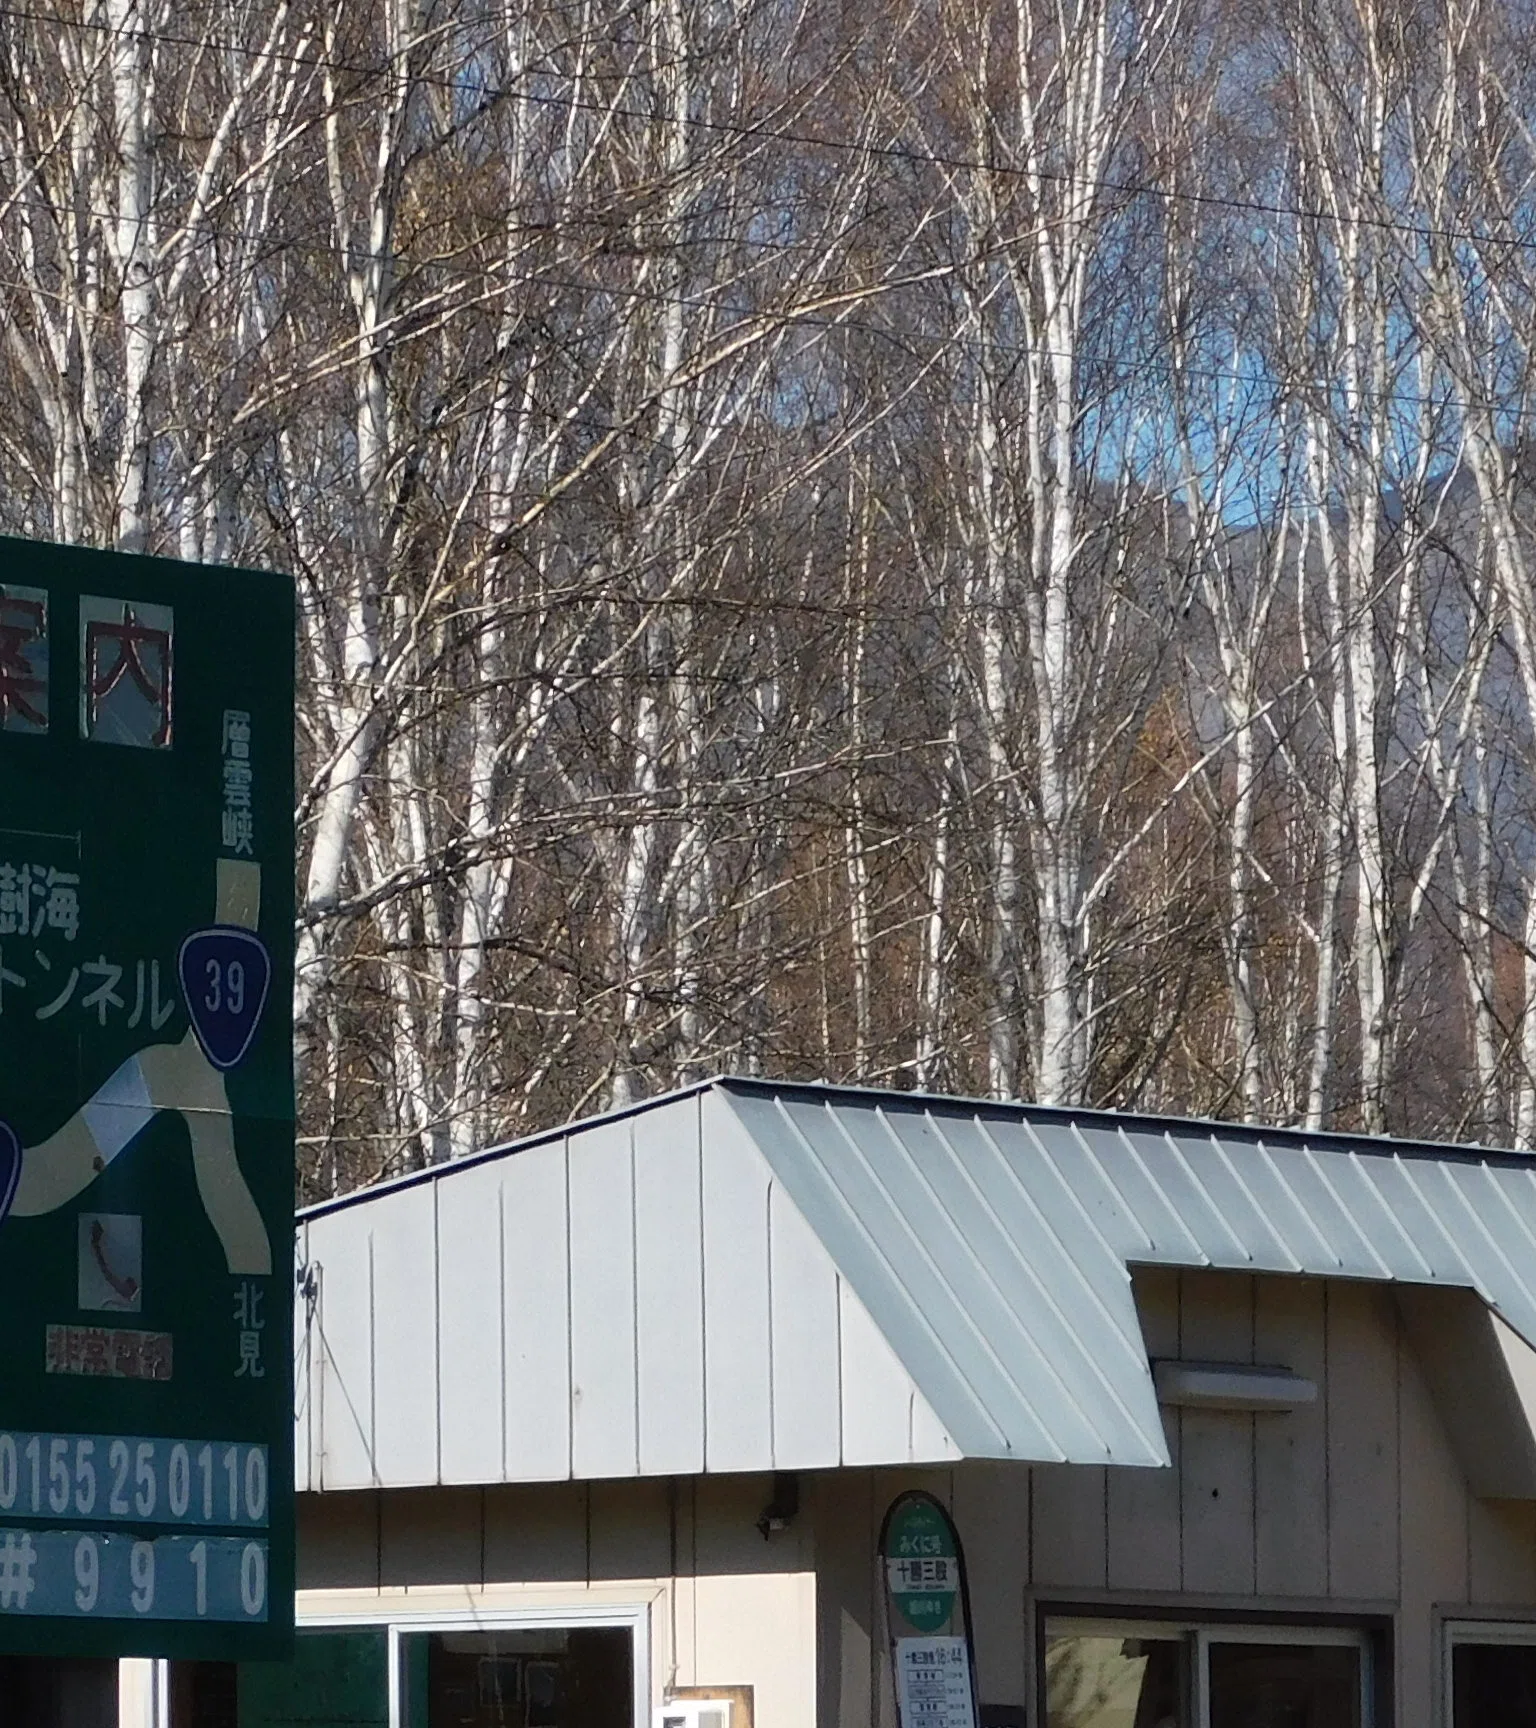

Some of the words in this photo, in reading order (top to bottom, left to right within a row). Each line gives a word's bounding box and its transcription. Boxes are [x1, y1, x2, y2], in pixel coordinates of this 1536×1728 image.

[221, 709, 255, 856] 層雲峡
[205, 958, 245, 1014] 39
[232, 1281, 266, 1378] 北見
